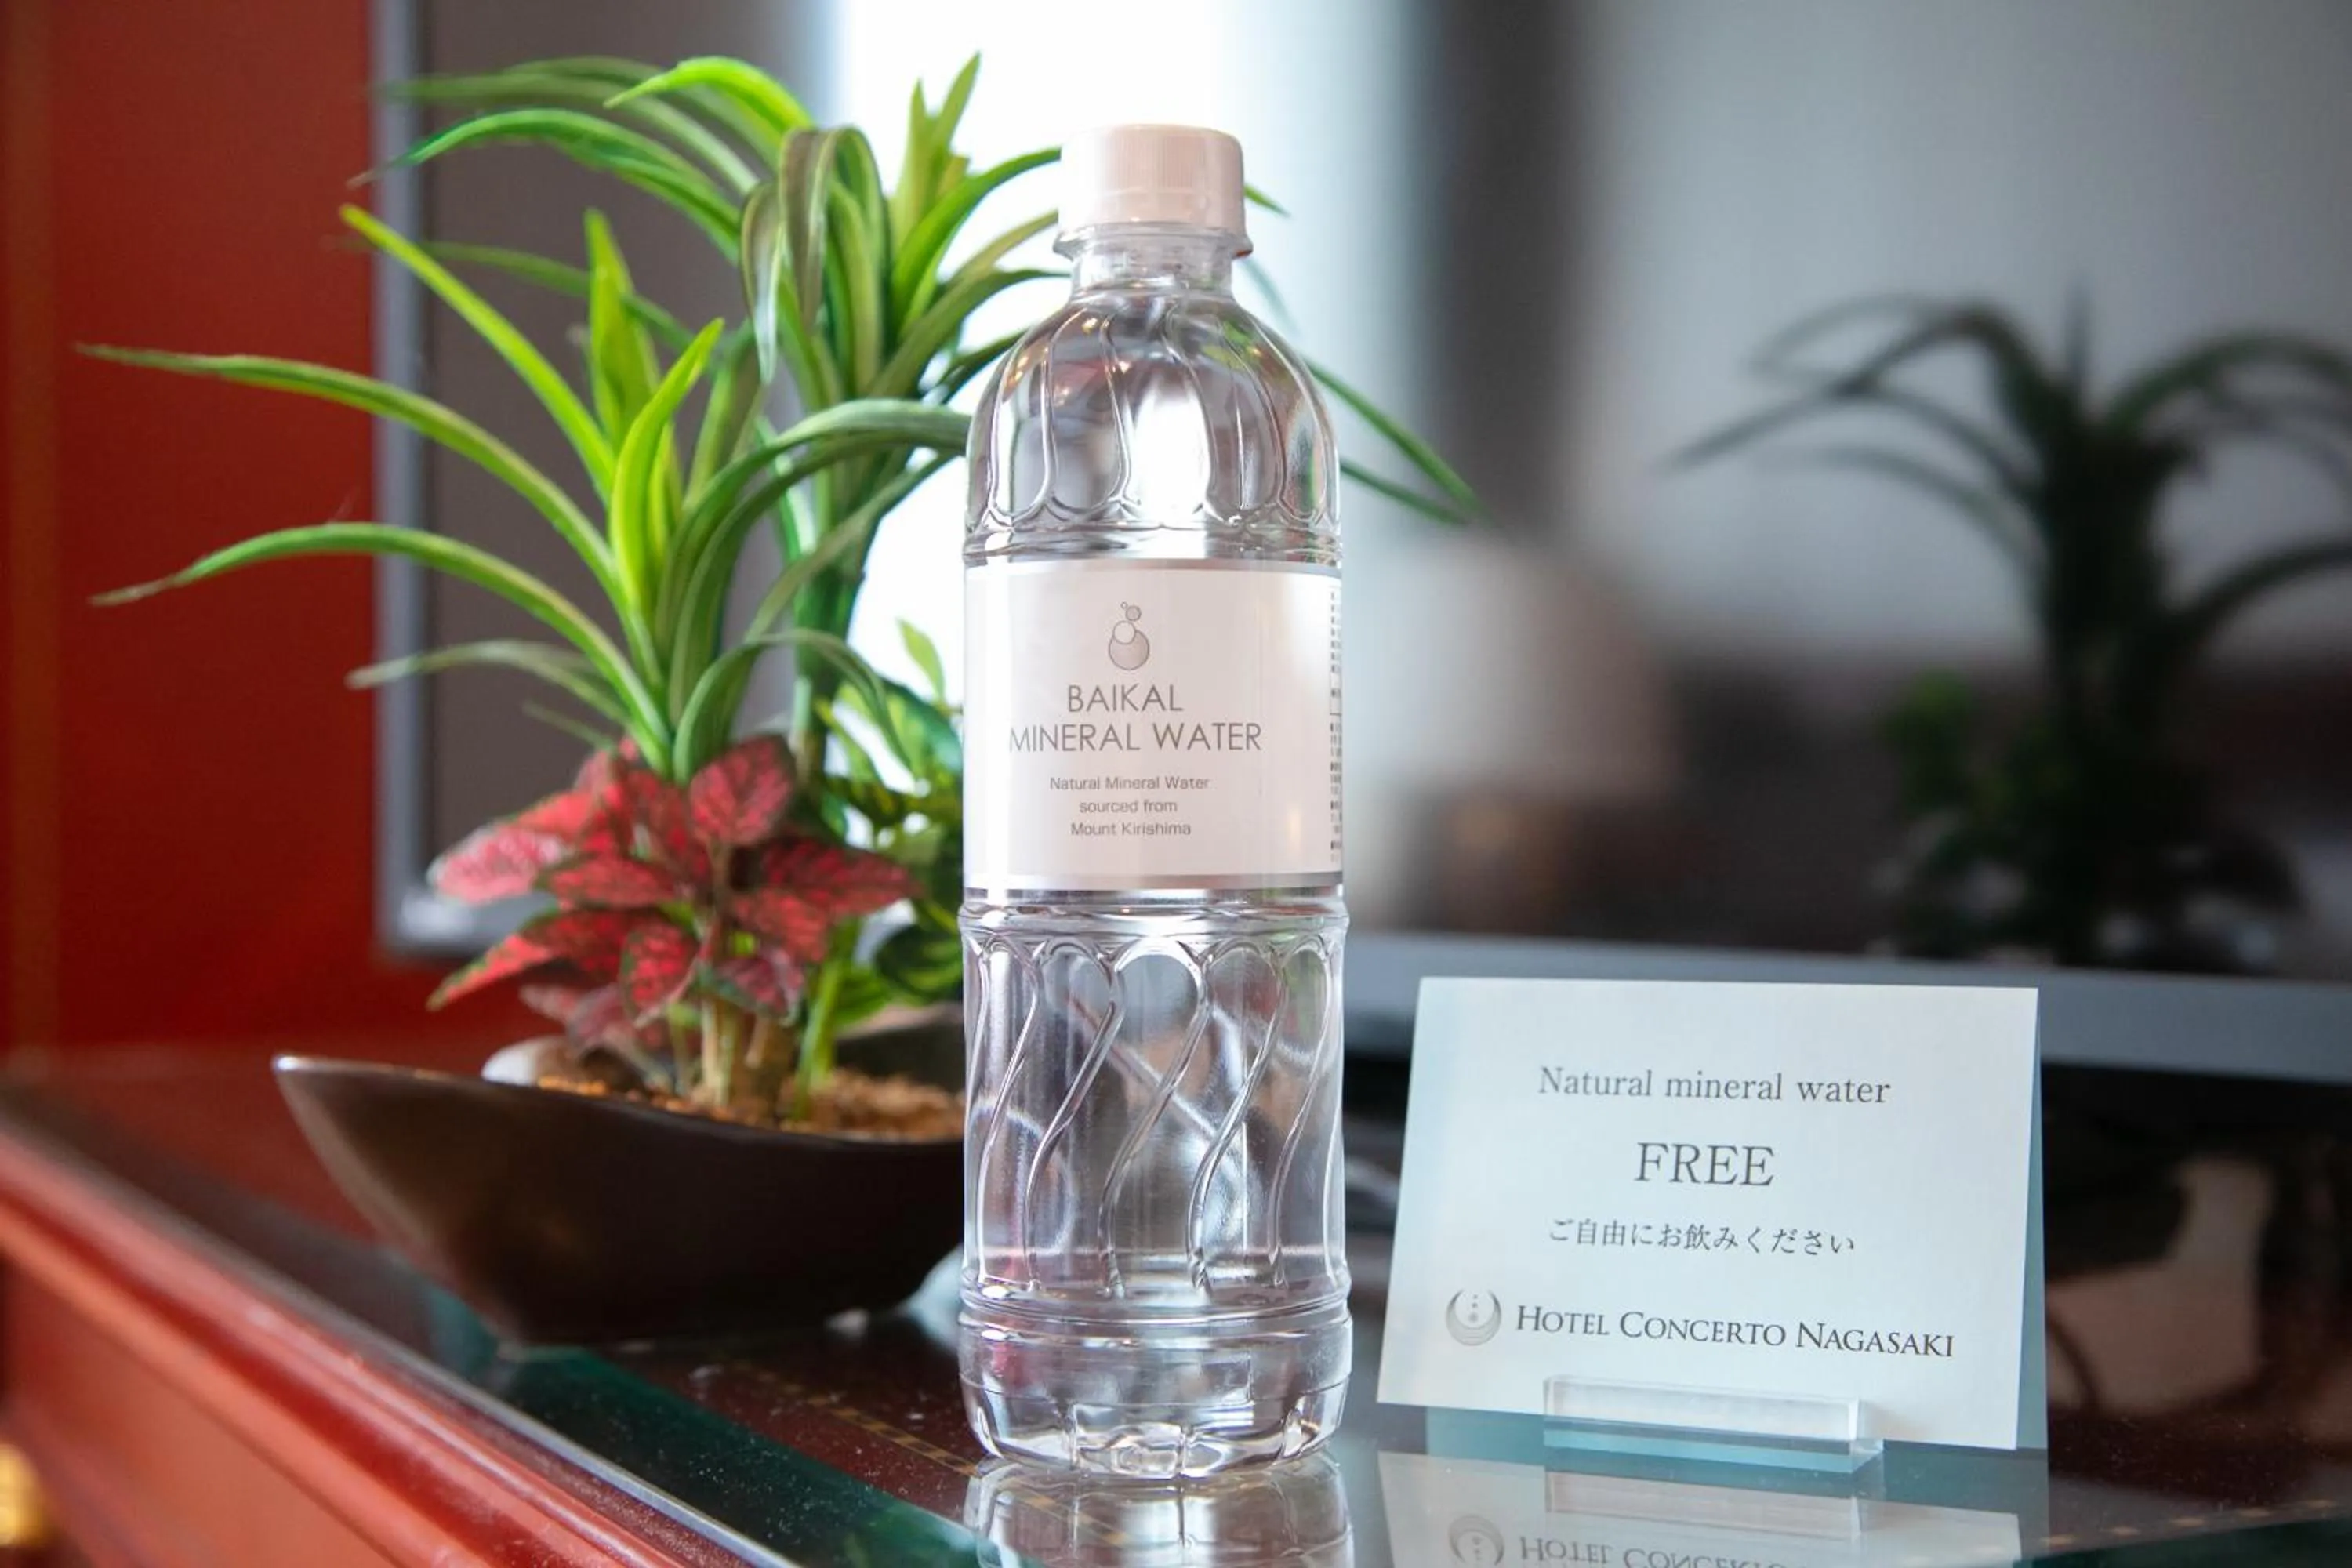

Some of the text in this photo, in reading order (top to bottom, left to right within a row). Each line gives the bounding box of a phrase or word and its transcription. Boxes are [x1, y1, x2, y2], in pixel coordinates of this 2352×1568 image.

[1068, 684, 1184, 713] BAIKAL
[1010, 722, 1261, 752] MINERAL WATER
[1050, 776, 1210, 790] Natural Mineral Water
[1079, 799, 1178, 814] sourced from
[1071, 822, 1192, 836] Mount Kirishima
[1538, 1066, 1891, 1103] Natural mineral water
[1634, 1142, 1775, 1186] FREE
[1549, 1218, 1855, 1256] ご自由にお飲みください
[1516, 1305, 1955, 1357] HOTEL CONCERTO NAGASAKI
